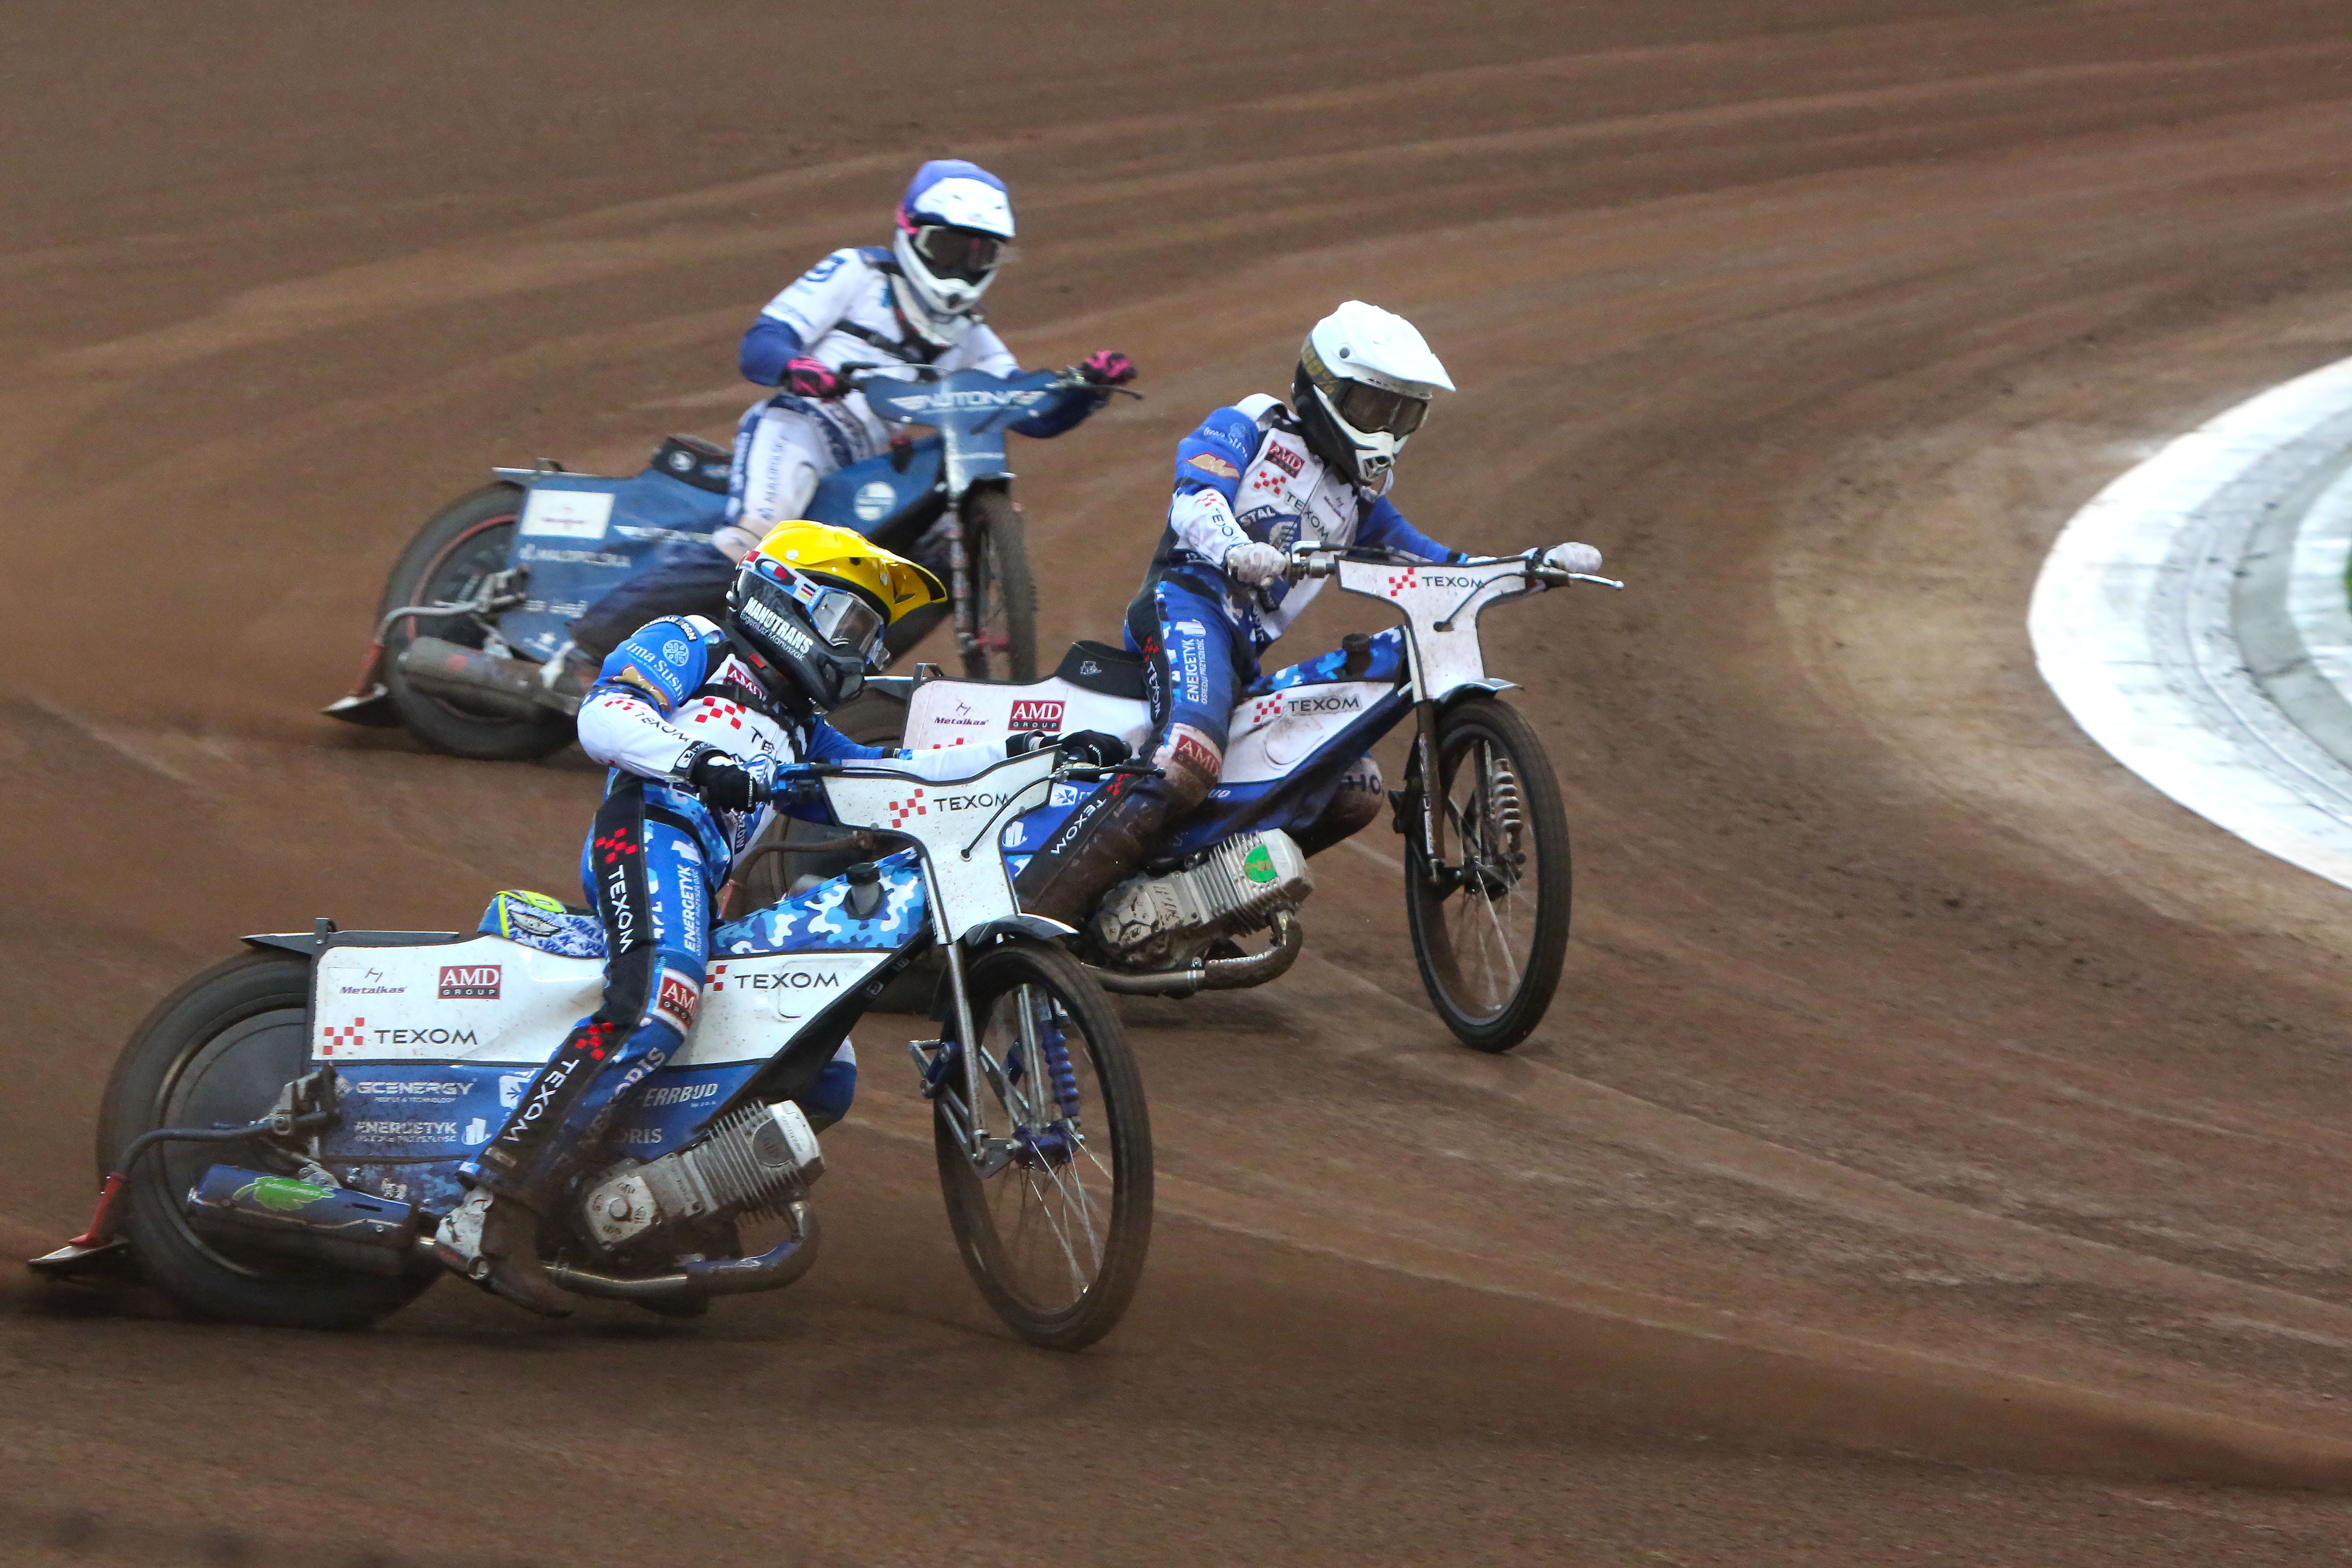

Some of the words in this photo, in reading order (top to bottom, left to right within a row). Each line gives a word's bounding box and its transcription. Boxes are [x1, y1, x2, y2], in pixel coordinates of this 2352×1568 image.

[1422, 576, 1486, 588] TEXOM
[743, 597, 814, 654] MANUTRANS
[1012, 703, 1062, 719] AMD
[1288, 698, 1360, 713] TEXOM
[934, 716, 987, 725] Metalkas
[933, 793, 1009, 813] TEXOM
[1050, 798, 1107, 855] TEXOM
[608, 864, 634, 953] TEXOM
[676, 864, 696, 953] ENERGETYK
[441, 968, 499, 987] AMD
[735, 972, 840, 989] TEXOM
[340, 986, 404, 995] Metalkas
[662, 983, 695, 1017] AM
[373, 1028, 478, 1045] TEXOM
[502, 1059, 579, 1142] TEXOM
[639, 1083, 719, 1107] ERRBUD
